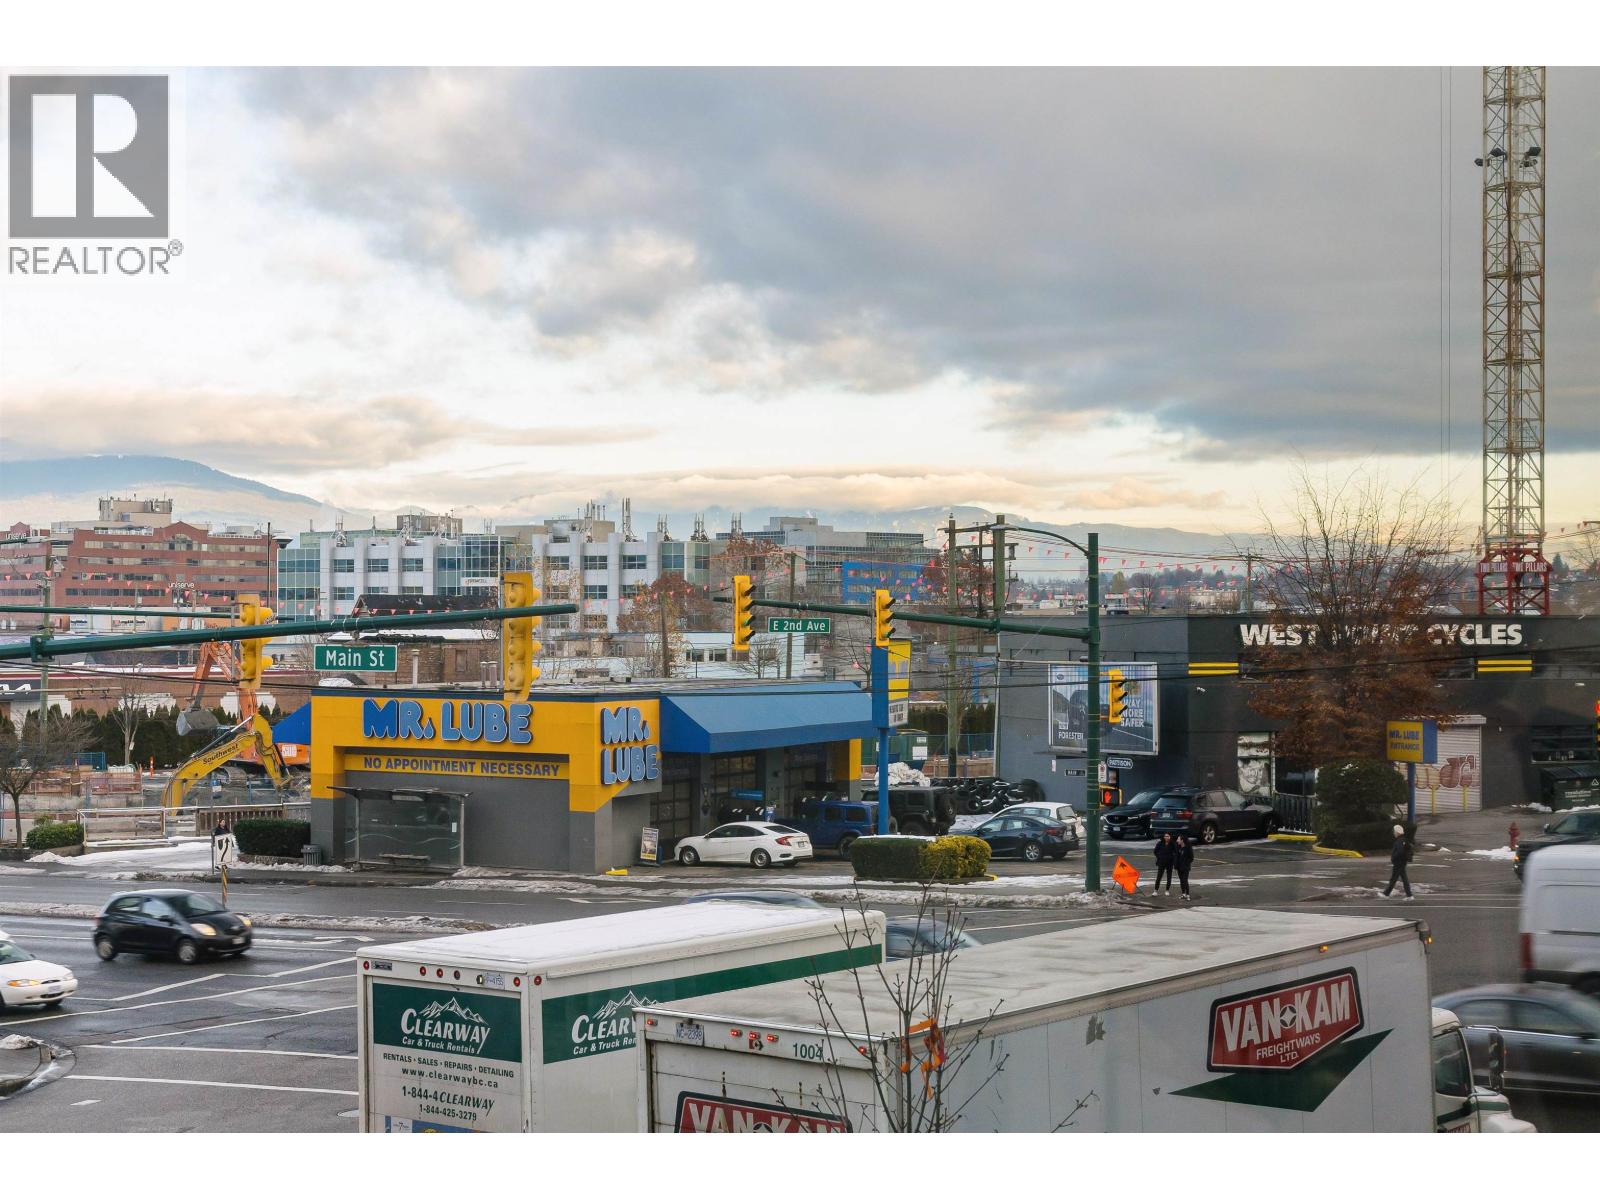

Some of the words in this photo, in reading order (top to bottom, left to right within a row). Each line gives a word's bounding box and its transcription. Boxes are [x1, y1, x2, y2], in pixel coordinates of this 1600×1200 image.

[1526, 562, 1547, 572] PILLARS
[773, 620, 778, 631] E
[783, 619, 802, 632] 2nd
[806, 619, 826, 632] Ave
[1240, 624, 1320, 646] WEST
[1428, 624, 1523, 645] CYCLES
[326, 650, 361, 666] Main
[369, 650, 384, 666] St
[440, 701, 534, 744] LUBE
[1120, 719, 1144, 728] SAFER
[1058, 731, 1084, 740] FORESTER
[202, 743, 239, 765] Southwest
[601, 744, 660, 784] LUBE
[364, 756, 382, 769] NO
[385, 758, 476, 774] APPOINTMENT
[480, 761, 560, 777] NECESSARY
[1221, 997, 1280, 1052] VAN
[1294, 980, 1350, 1035] KAM
[400, 1008, 490, 1054] CLEARWAY
[572, 1014, 636, 1044] CLEAR
[402, 1036, 416, 1046] Car
[416, 1039, 423, 1047] &
[424, 1040, 444, 1050] Truck
[446, 1042, 475, 1054] Rentals
[573, 1046, 587, 1055] Car
[590, 1043, 597, 1052] &
[598, 1040, 620, 1050] Truck
[1256, 1032, 1320, 1060] FREIGHTWAYS
[383, 1052, 412, 1064] RENTALS
[417, 1057, 438, 1068] SALES
[444, 1060, 472, 1072] REPAIRS
[478, 1066, 514, 1078] DETAILING
[402, 1068, 498, 1089] www.clearwaybc.ca
[419, 1104, 477, 1122] 1-844-425-3279
